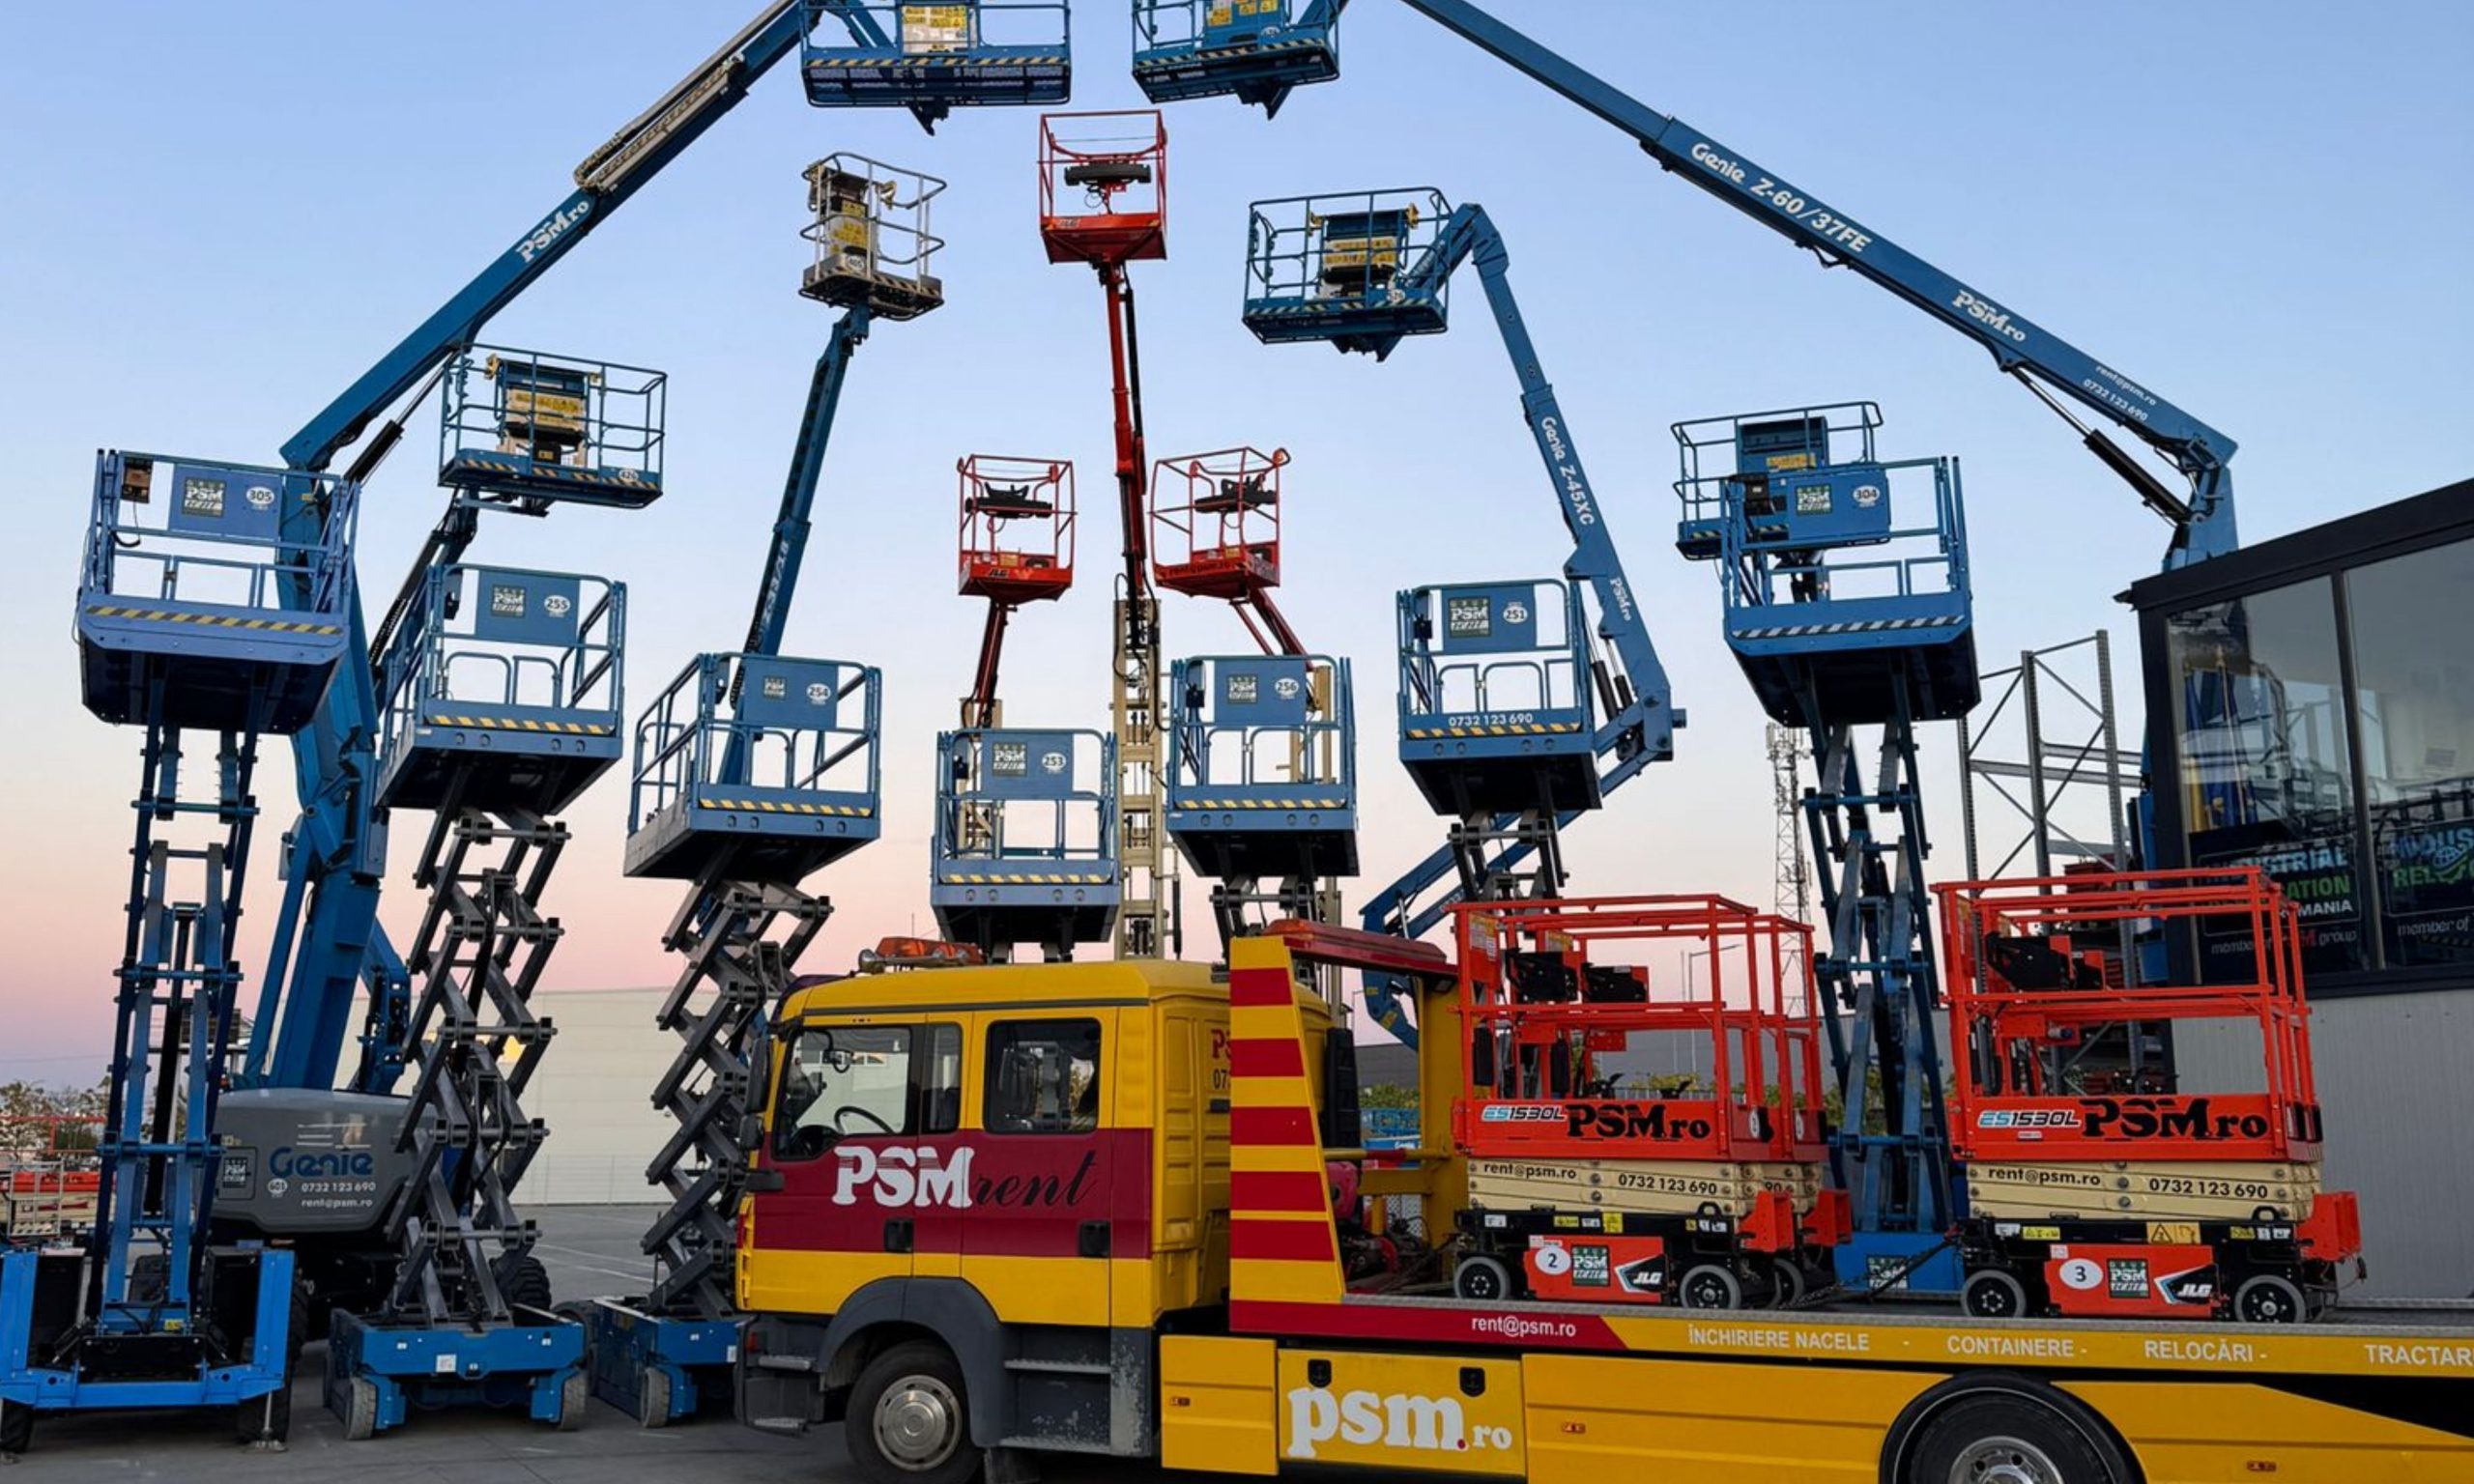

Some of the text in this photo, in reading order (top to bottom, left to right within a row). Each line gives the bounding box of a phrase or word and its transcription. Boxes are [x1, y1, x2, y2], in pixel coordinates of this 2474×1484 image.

[1691, 142, 1872, 252] Genie Z-60/37FE
[2083, 379, 2148, 421] 0732 123 690
[1541, 416, 1595, 526] Genie Z-45XC
[249, 490, 273, 501] 305
[1506, 609, 1525, 620] 251
[1448, 712, 1534, 728] 0732 123 690
[2287, 875, 2351, 899] ATION
[1482, 1105, 1566, 1121] ES1530L
[1979, 1111, 2080, 1127] ES1530L
[269, 1147, 373, 1179] Genie
[302, 1181, 377, 1193] 0732 123 690
[1483, 1161, 1717, 1195] rent@psm.ro 0732 123 690
[1988, 1166, 2269, 1199] rent@psm.ro 0732 123 690
[302, 1198, 373, 1210] rent@psm.ro
[1547, 1252, 1558, 1269] 2
[1573, 1255, 1608, 1270] PSM
[1633, 1271, 1662, 1284] JLG
[2074, 1265, 2087, 1282] 3
[2111, 1268, 2147, 1282] PSM
[2176, 1283, 2212, 1297] JLG
[1471, 1315, 1577, 1338] rent@psm.ro
[1688, 1324, 1790, 1348] ÎNCHIRIERE
[1795, 1330, 1870, 1352] NACELE
[1946, 1335, 2074, 1357] CONTAINERE
[2143, 1338, 2253, 1363] RELOCĂRI
[2364, 1343, 2474, 1367] TRACTAR
[1287, 1386, 1512, 1459] psm.ro
